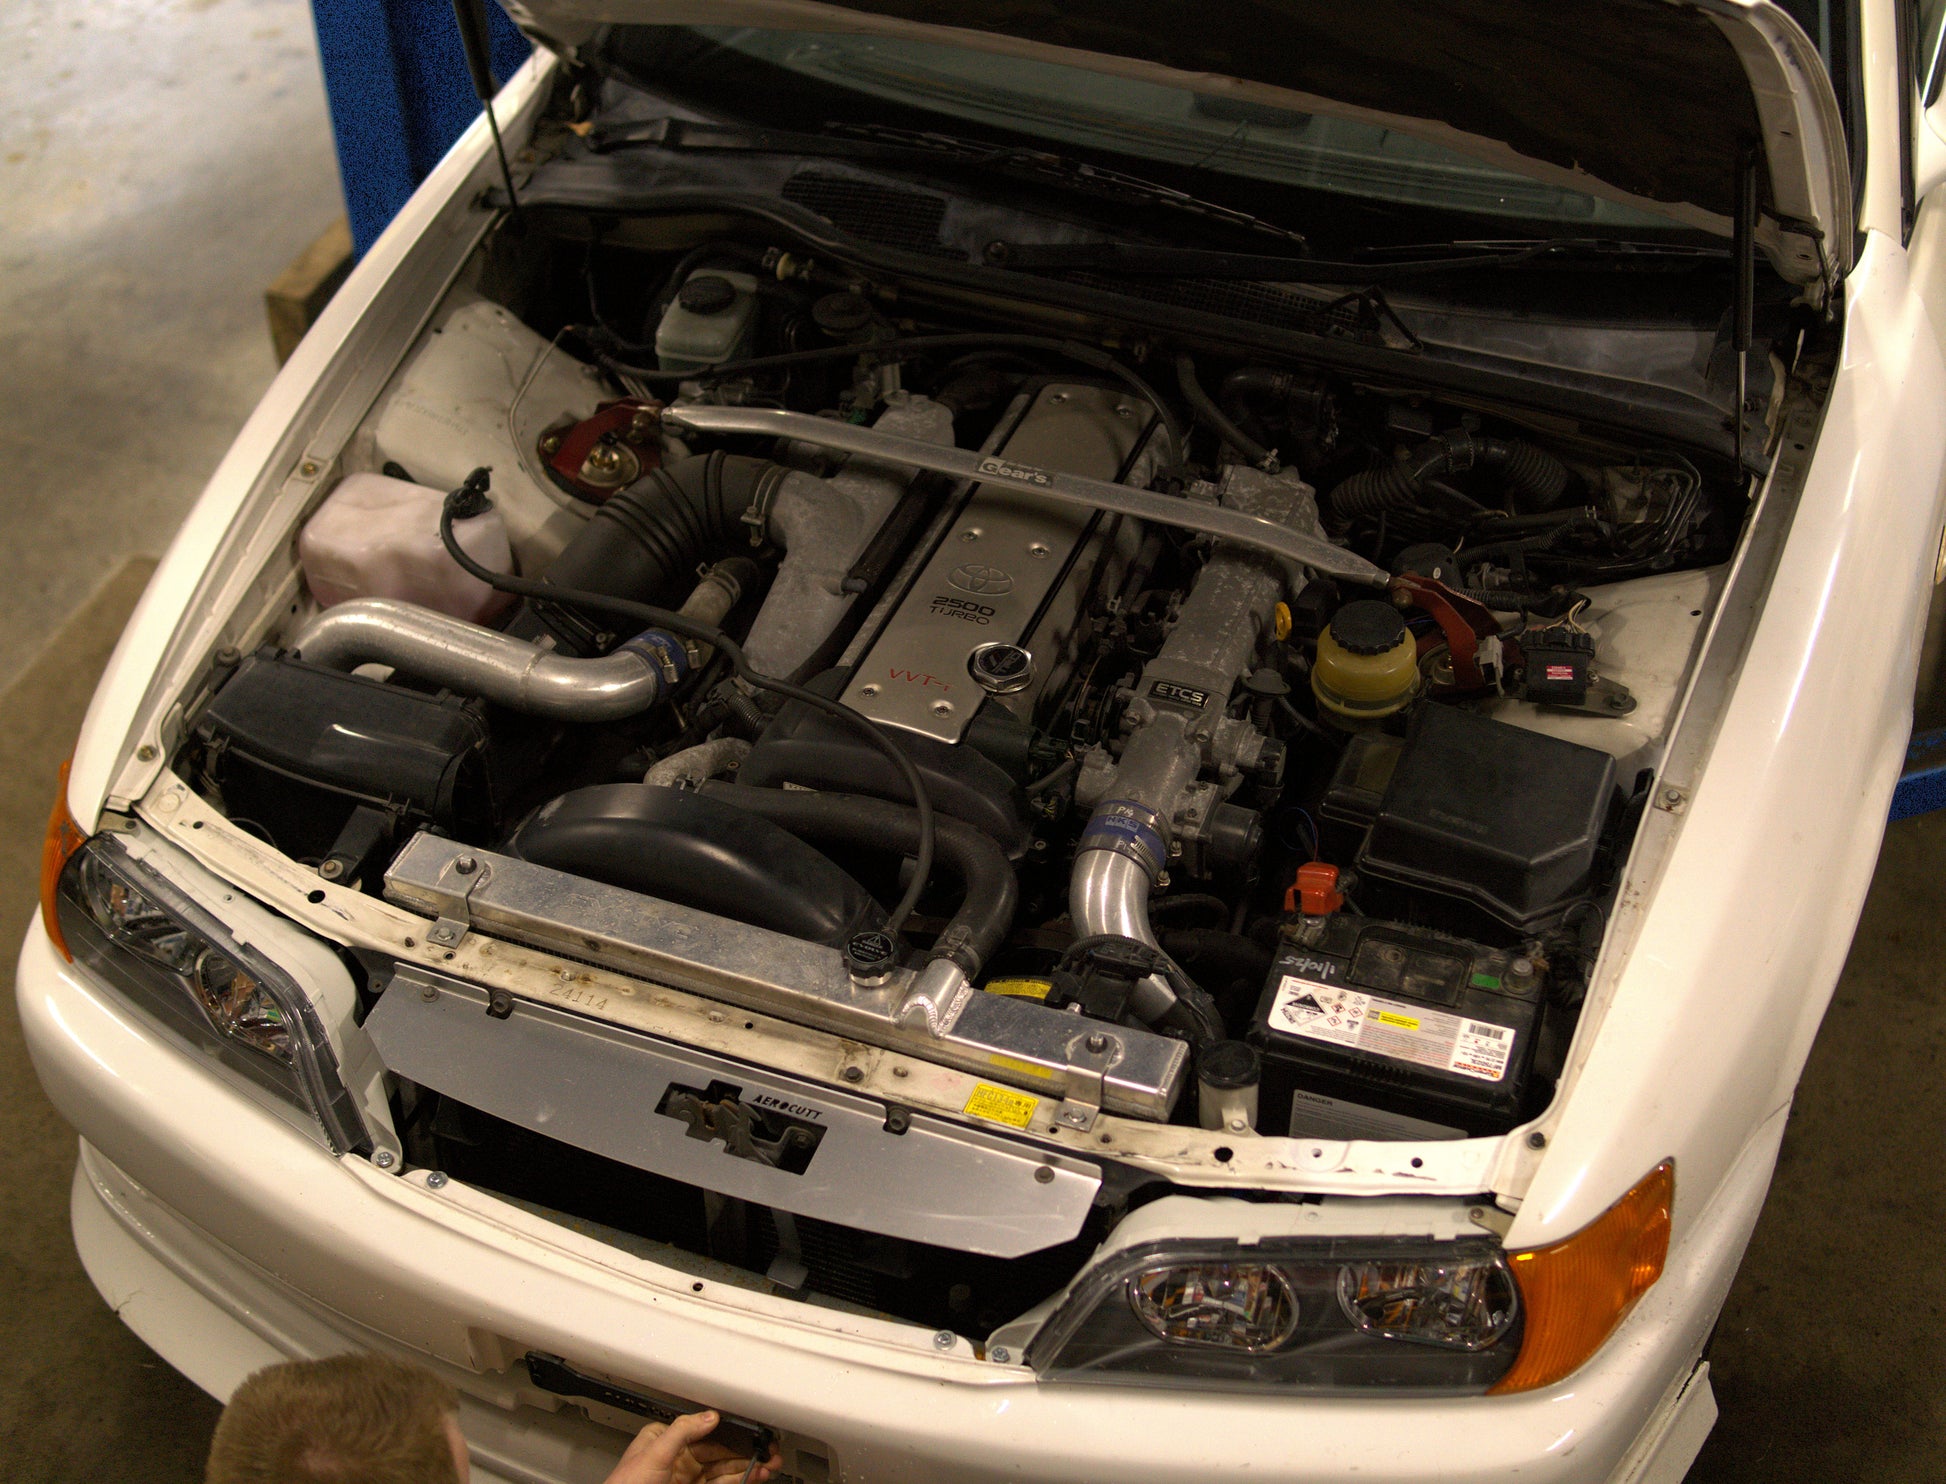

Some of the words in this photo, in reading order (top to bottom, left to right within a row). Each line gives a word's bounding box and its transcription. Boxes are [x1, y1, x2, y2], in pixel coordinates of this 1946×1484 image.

[981, 461, 1048, 484] Gear's
[929, 605, 990, 626] TURBO
[932, 596, 996, 617] 2500
[889, 668, 950, 692] VVT-i
[1155, 682, 1205, 702] ETCS
[1106, 816, 1138, 829] HKS
[753, 1095, 823, 1120] AEROCUTT
[1297, 1093, 1333, 1107] DANGER
